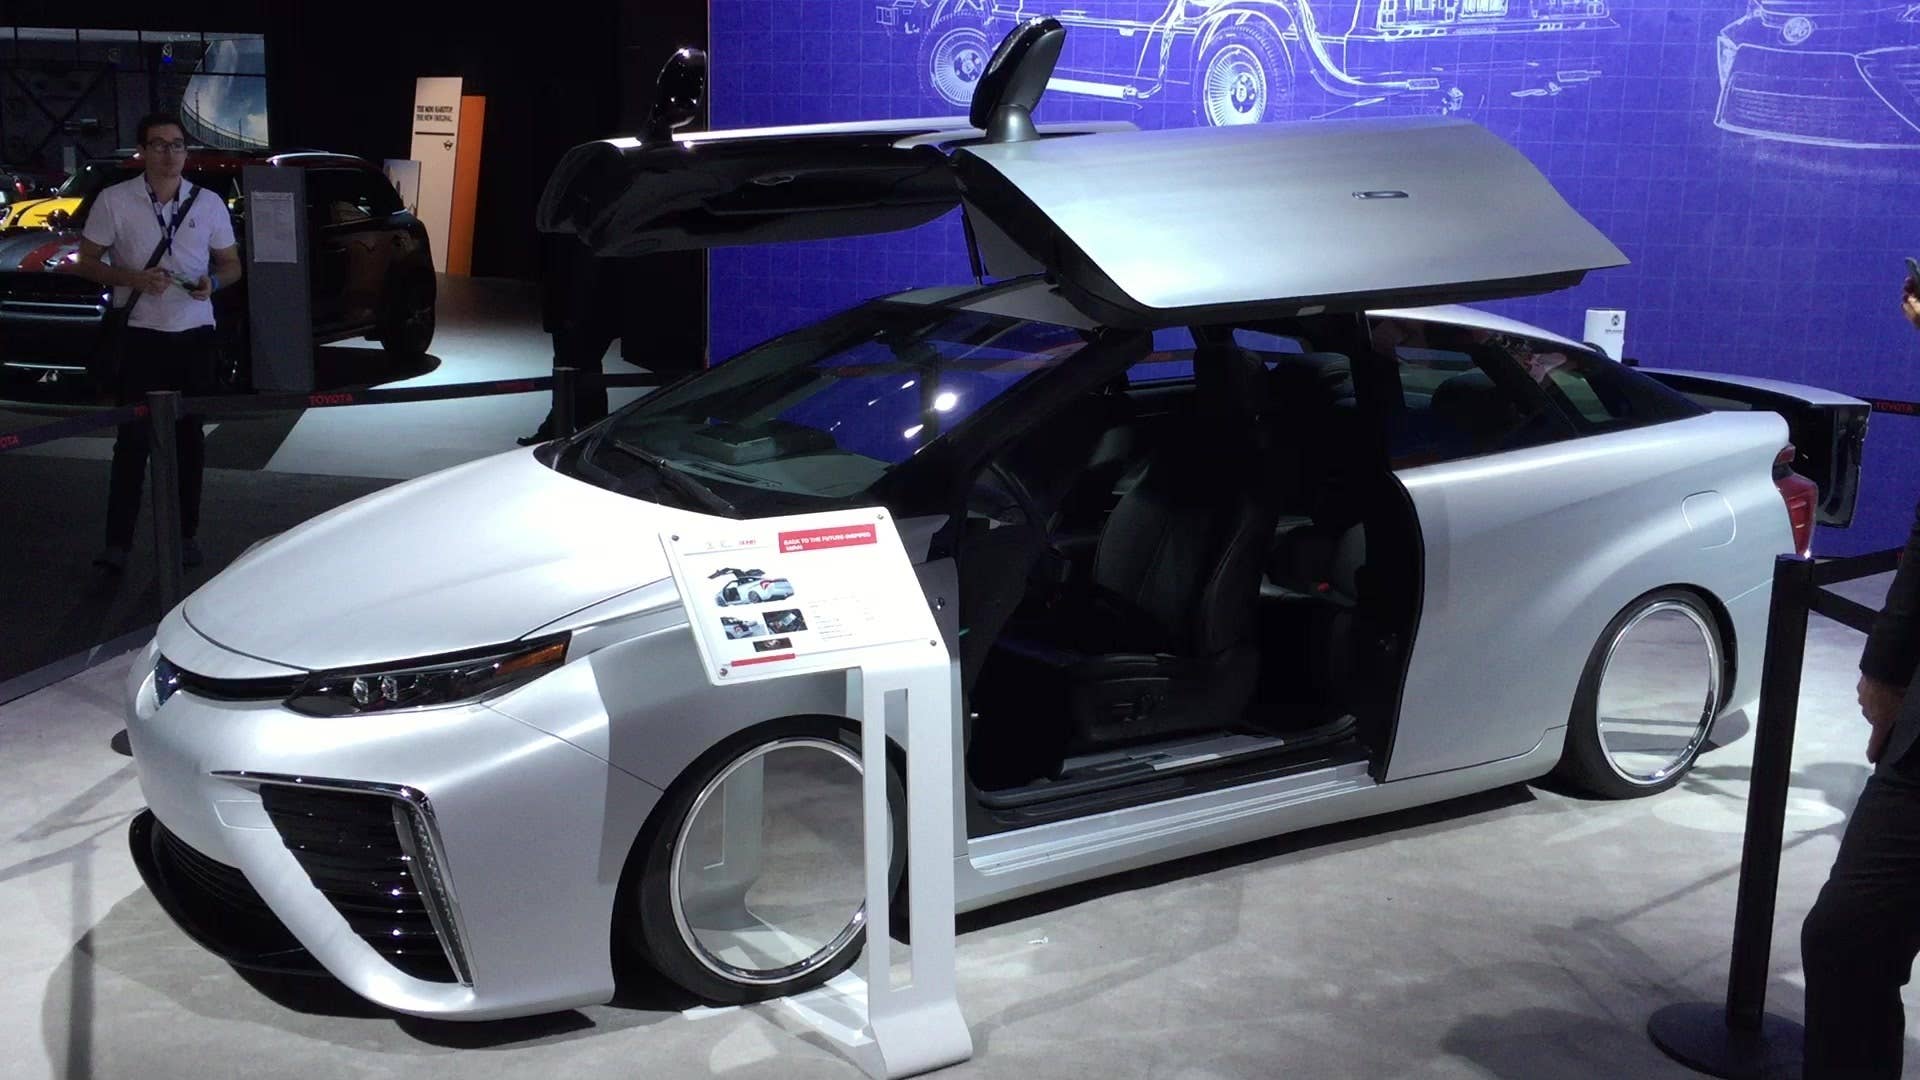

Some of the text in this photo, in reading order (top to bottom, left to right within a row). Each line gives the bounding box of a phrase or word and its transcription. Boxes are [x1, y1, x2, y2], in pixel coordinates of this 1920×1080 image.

[309, 394, 353, 405] TOYOTA
[1875, 401, 1913, 413] TOYOTA
[801, 537, 810, 545] TO
